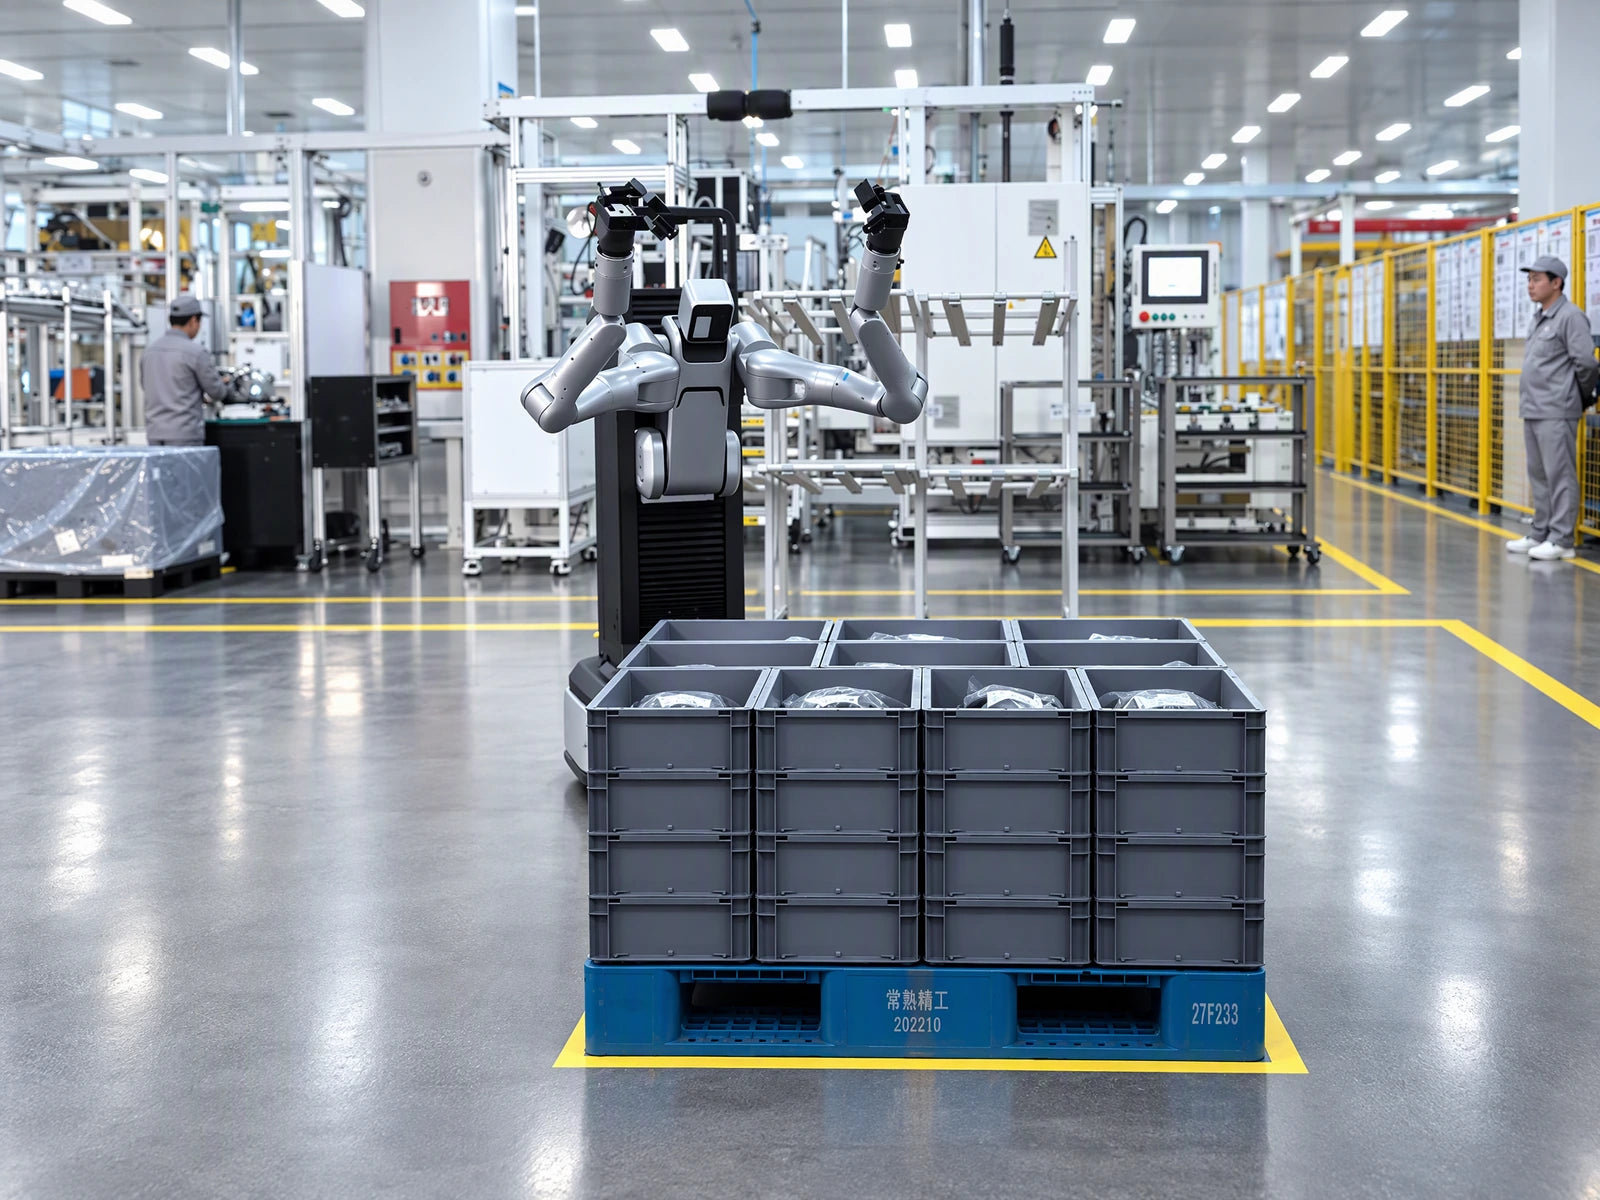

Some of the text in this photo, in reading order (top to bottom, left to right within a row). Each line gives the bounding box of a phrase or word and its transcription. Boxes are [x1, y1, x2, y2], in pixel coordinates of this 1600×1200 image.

[886, 988, 949, 1011] 常熟精工
[893, 1016, 942, 1033] 202210
[1191, 1002, 1239, 1025] 27F233
